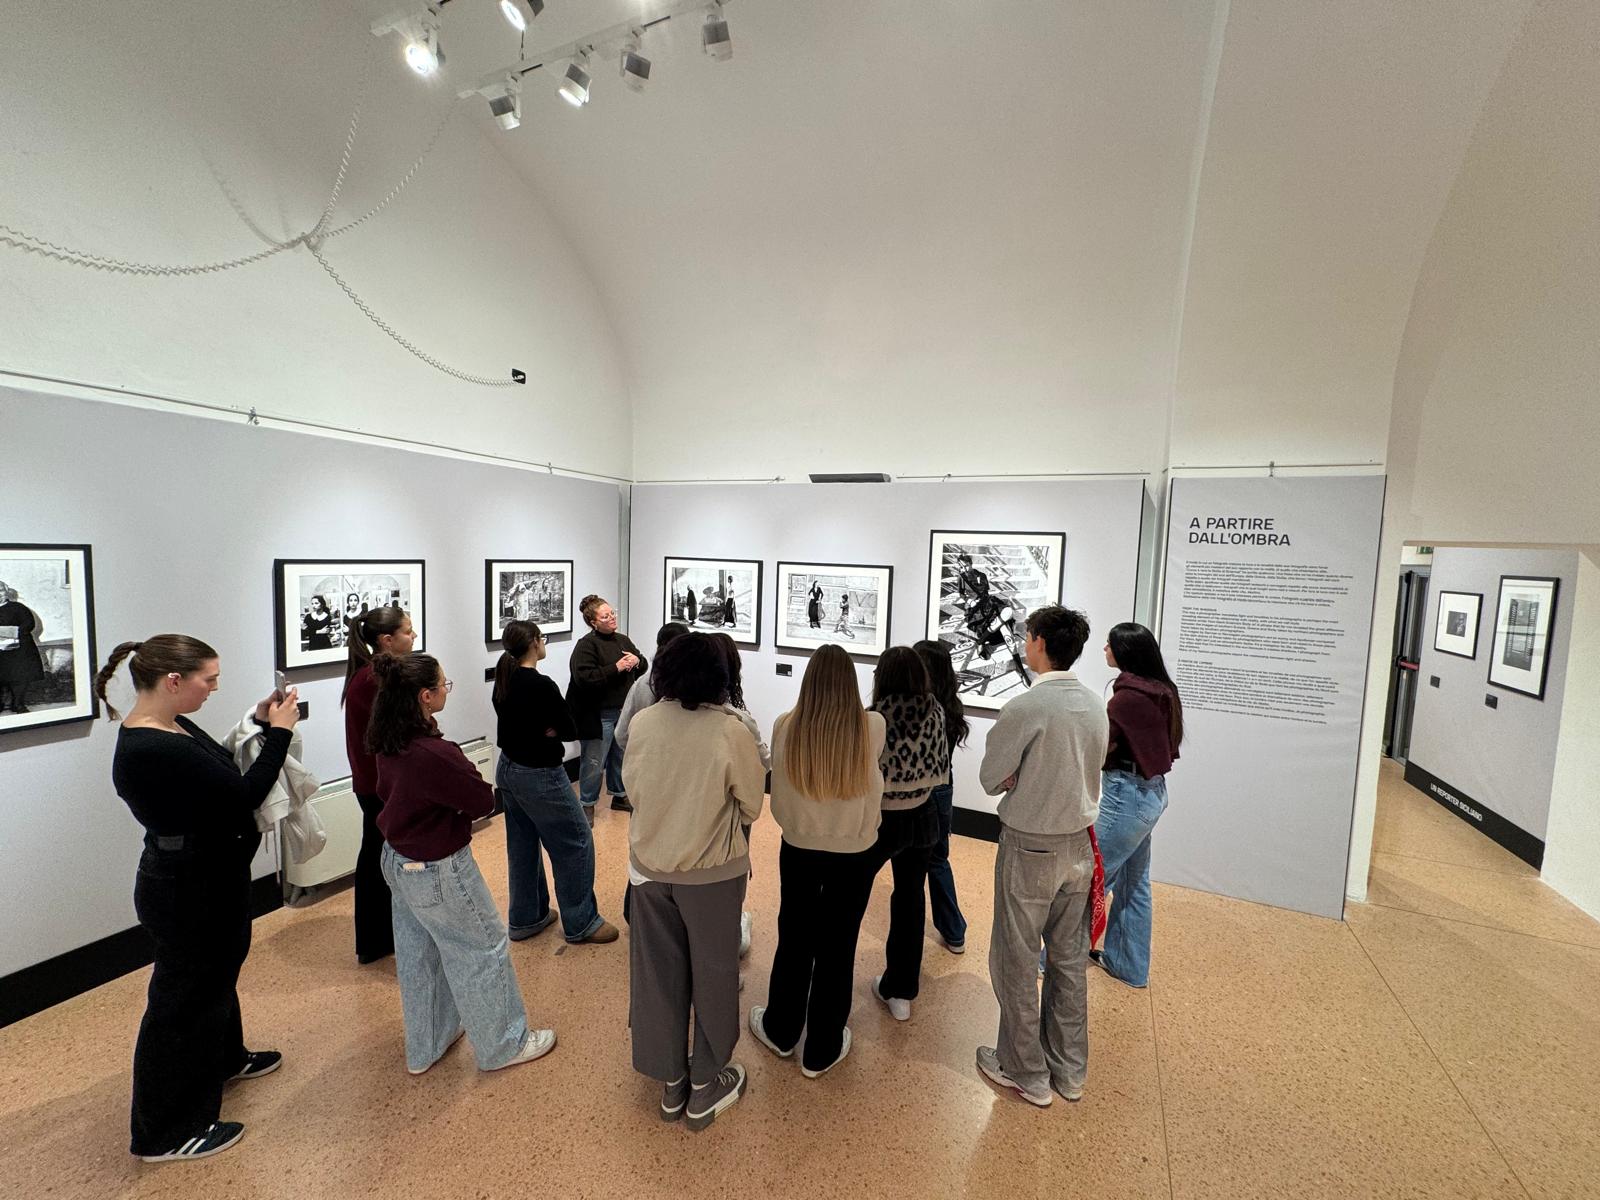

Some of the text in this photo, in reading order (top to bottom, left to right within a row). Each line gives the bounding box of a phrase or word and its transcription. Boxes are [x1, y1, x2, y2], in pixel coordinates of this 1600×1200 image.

[1189, 517, 1275, 530] A PARTIRE
[1188, 532, 1291, 546] DALL'OMBRA
